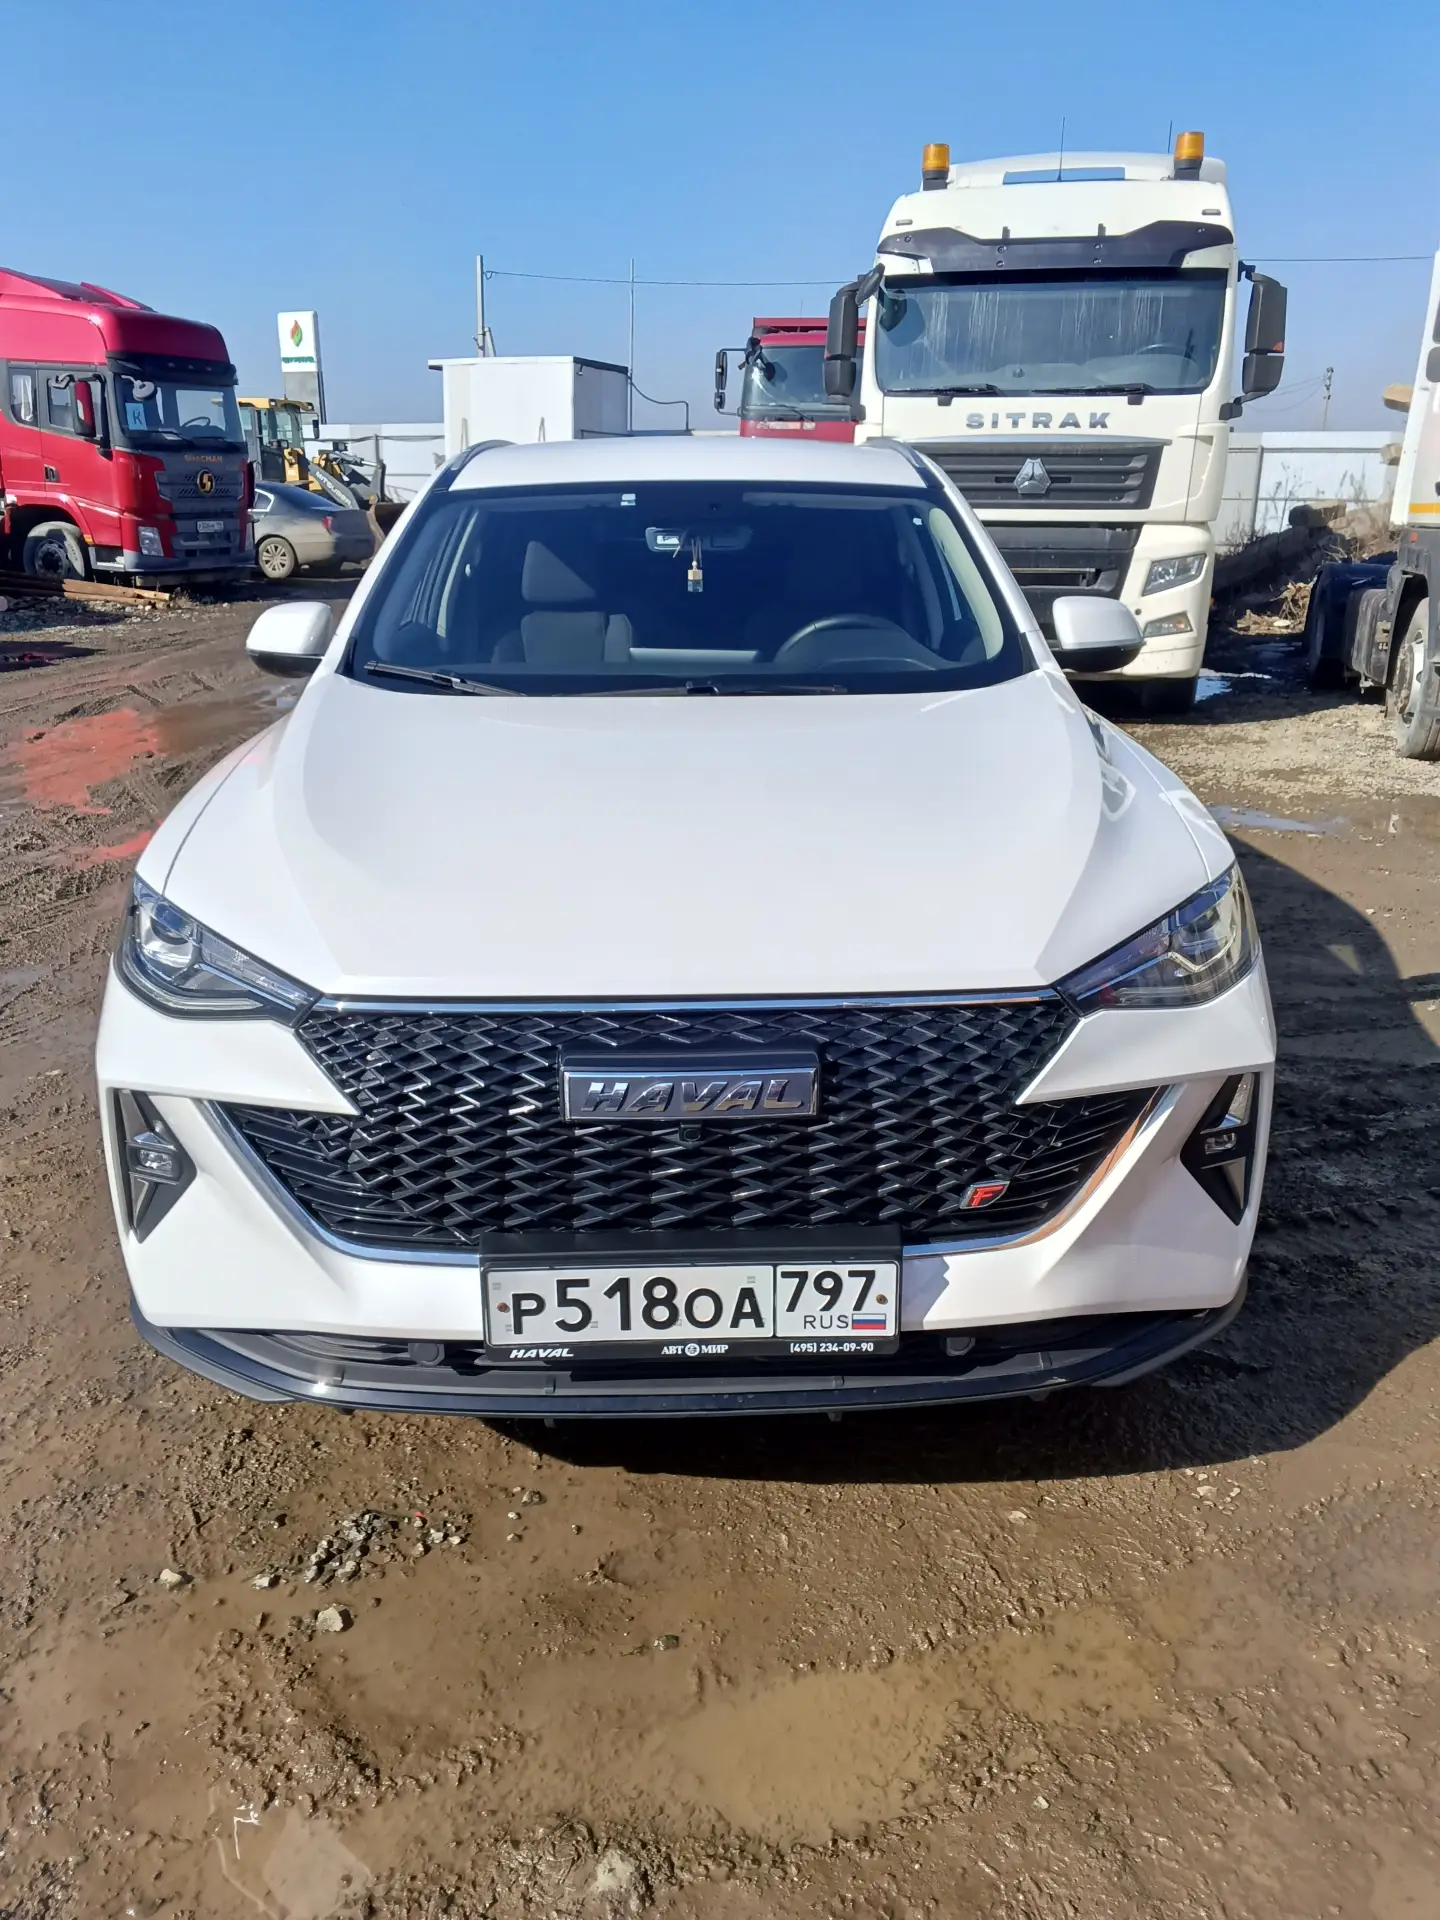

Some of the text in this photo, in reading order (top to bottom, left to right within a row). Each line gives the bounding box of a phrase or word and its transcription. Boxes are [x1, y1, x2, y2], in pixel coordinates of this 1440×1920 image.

[965, 412, 1111, 429] SITRAK
[580, 1079, 805, 1112] HAVAL
[780, 1269, 877, 1313] 797
[803, 1314, 850, 1330] RUS
[509, 1348, 575, 1359] HAVAL
[790, 1342, 874, 1353] (495) 234-09-90
